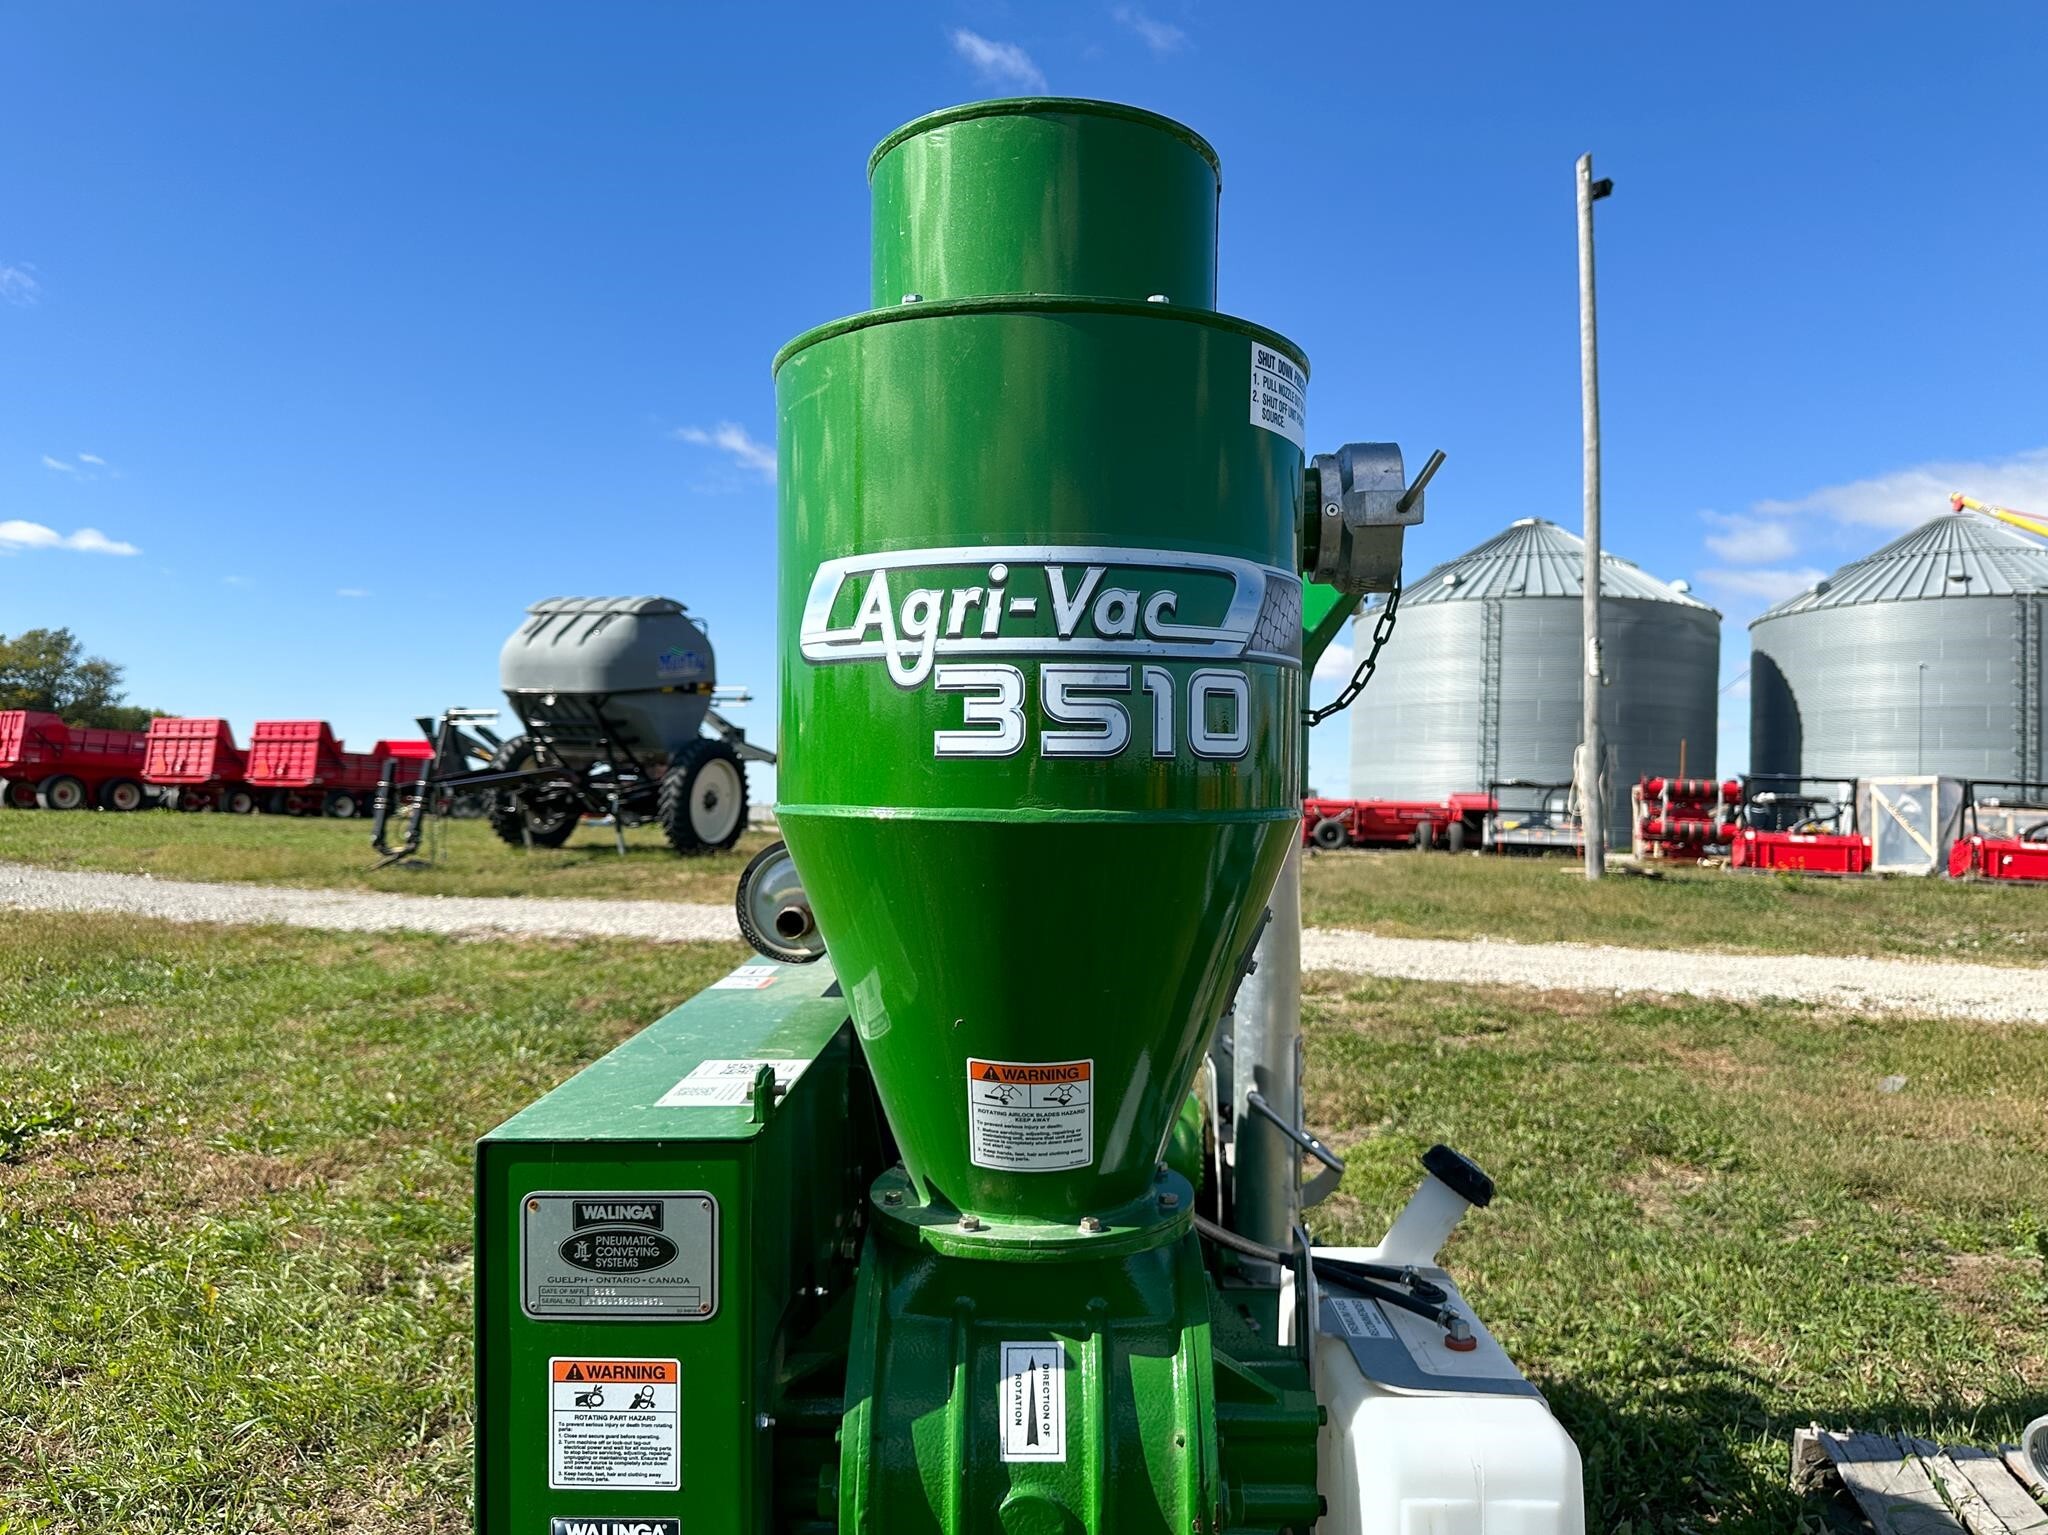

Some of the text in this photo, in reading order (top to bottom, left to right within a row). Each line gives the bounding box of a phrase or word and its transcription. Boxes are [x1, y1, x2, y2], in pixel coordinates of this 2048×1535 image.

[1258, 349, 1276, 370] SHUT
[1278, 358, 1293, 380] DOWN
[1253, 372, 1260, 386] 1.
[1262, 376, 1277, 393] PULL
[1252, 390, 1259, 403] 2.
[1262, 392, 1278, 410] SHUT
[1278, 400, 1288, 415] OFF
[1261, 407, 1285, 428] SOURCE.
[849, 563, 1179, 687] Agri-Vac
[934, 662, 1251, 760] 3510
[1001, 1067, 1080, 1081] WARNING
[1061, 1108, 1086, 1116] HAZARD
[582, 1205, 654, 1220] WALINGA
[595, 1235, 656, 1246] PNEUMATIC
[595, 1246, 660, 1257] CONVEYING
[595, 1258, 639, 1268] SYSTEMS
[547, 1276, 690, 1284] GUELPH ONTARIO CANADA
[586, 1365, 666, 1380] WARNING
[1042, 1363, 1050, 1438] DIRECTION OF
[564, 1523, 664, 1535] WALINGA
